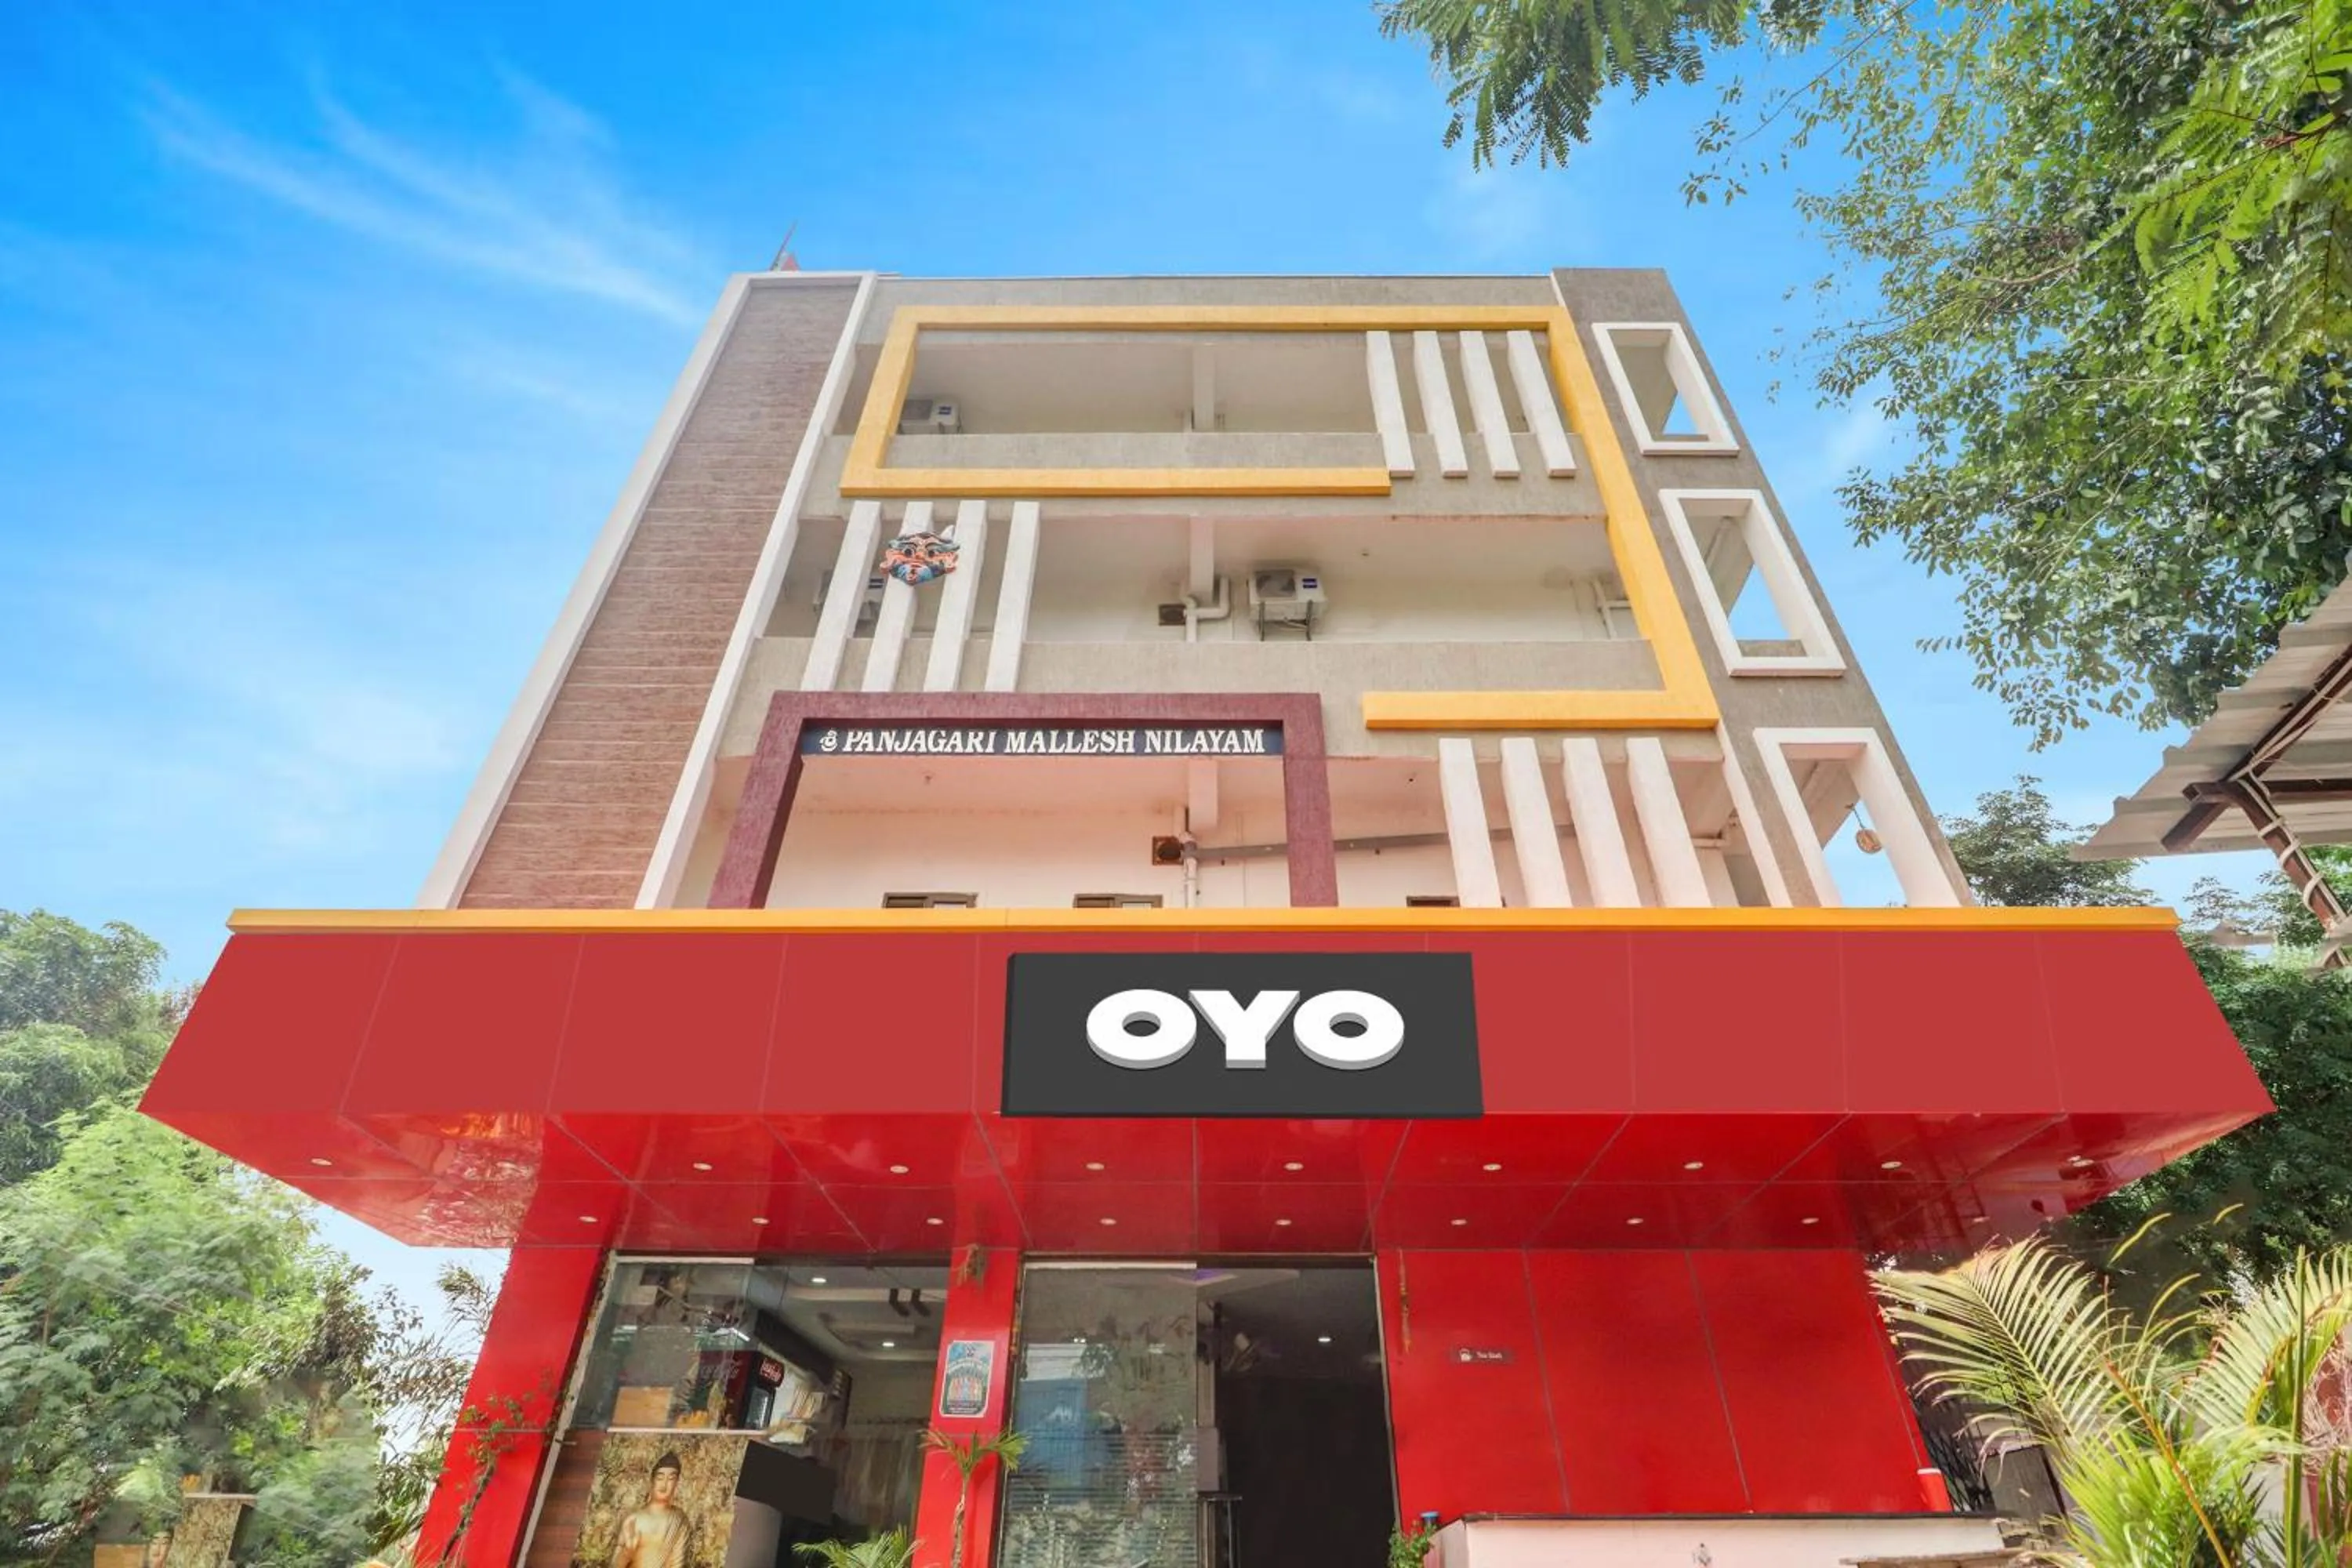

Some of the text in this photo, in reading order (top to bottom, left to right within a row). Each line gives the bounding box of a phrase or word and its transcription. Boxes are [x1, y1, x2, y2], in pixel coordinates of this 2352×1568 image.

[842, 731, 996, 753] PANJAGARI
[1004, 731, 1136, 753] MALLESH
[1144, 730, 1265, 753] NILAYAM
[1087, 989, 1405, 1070] OYO
